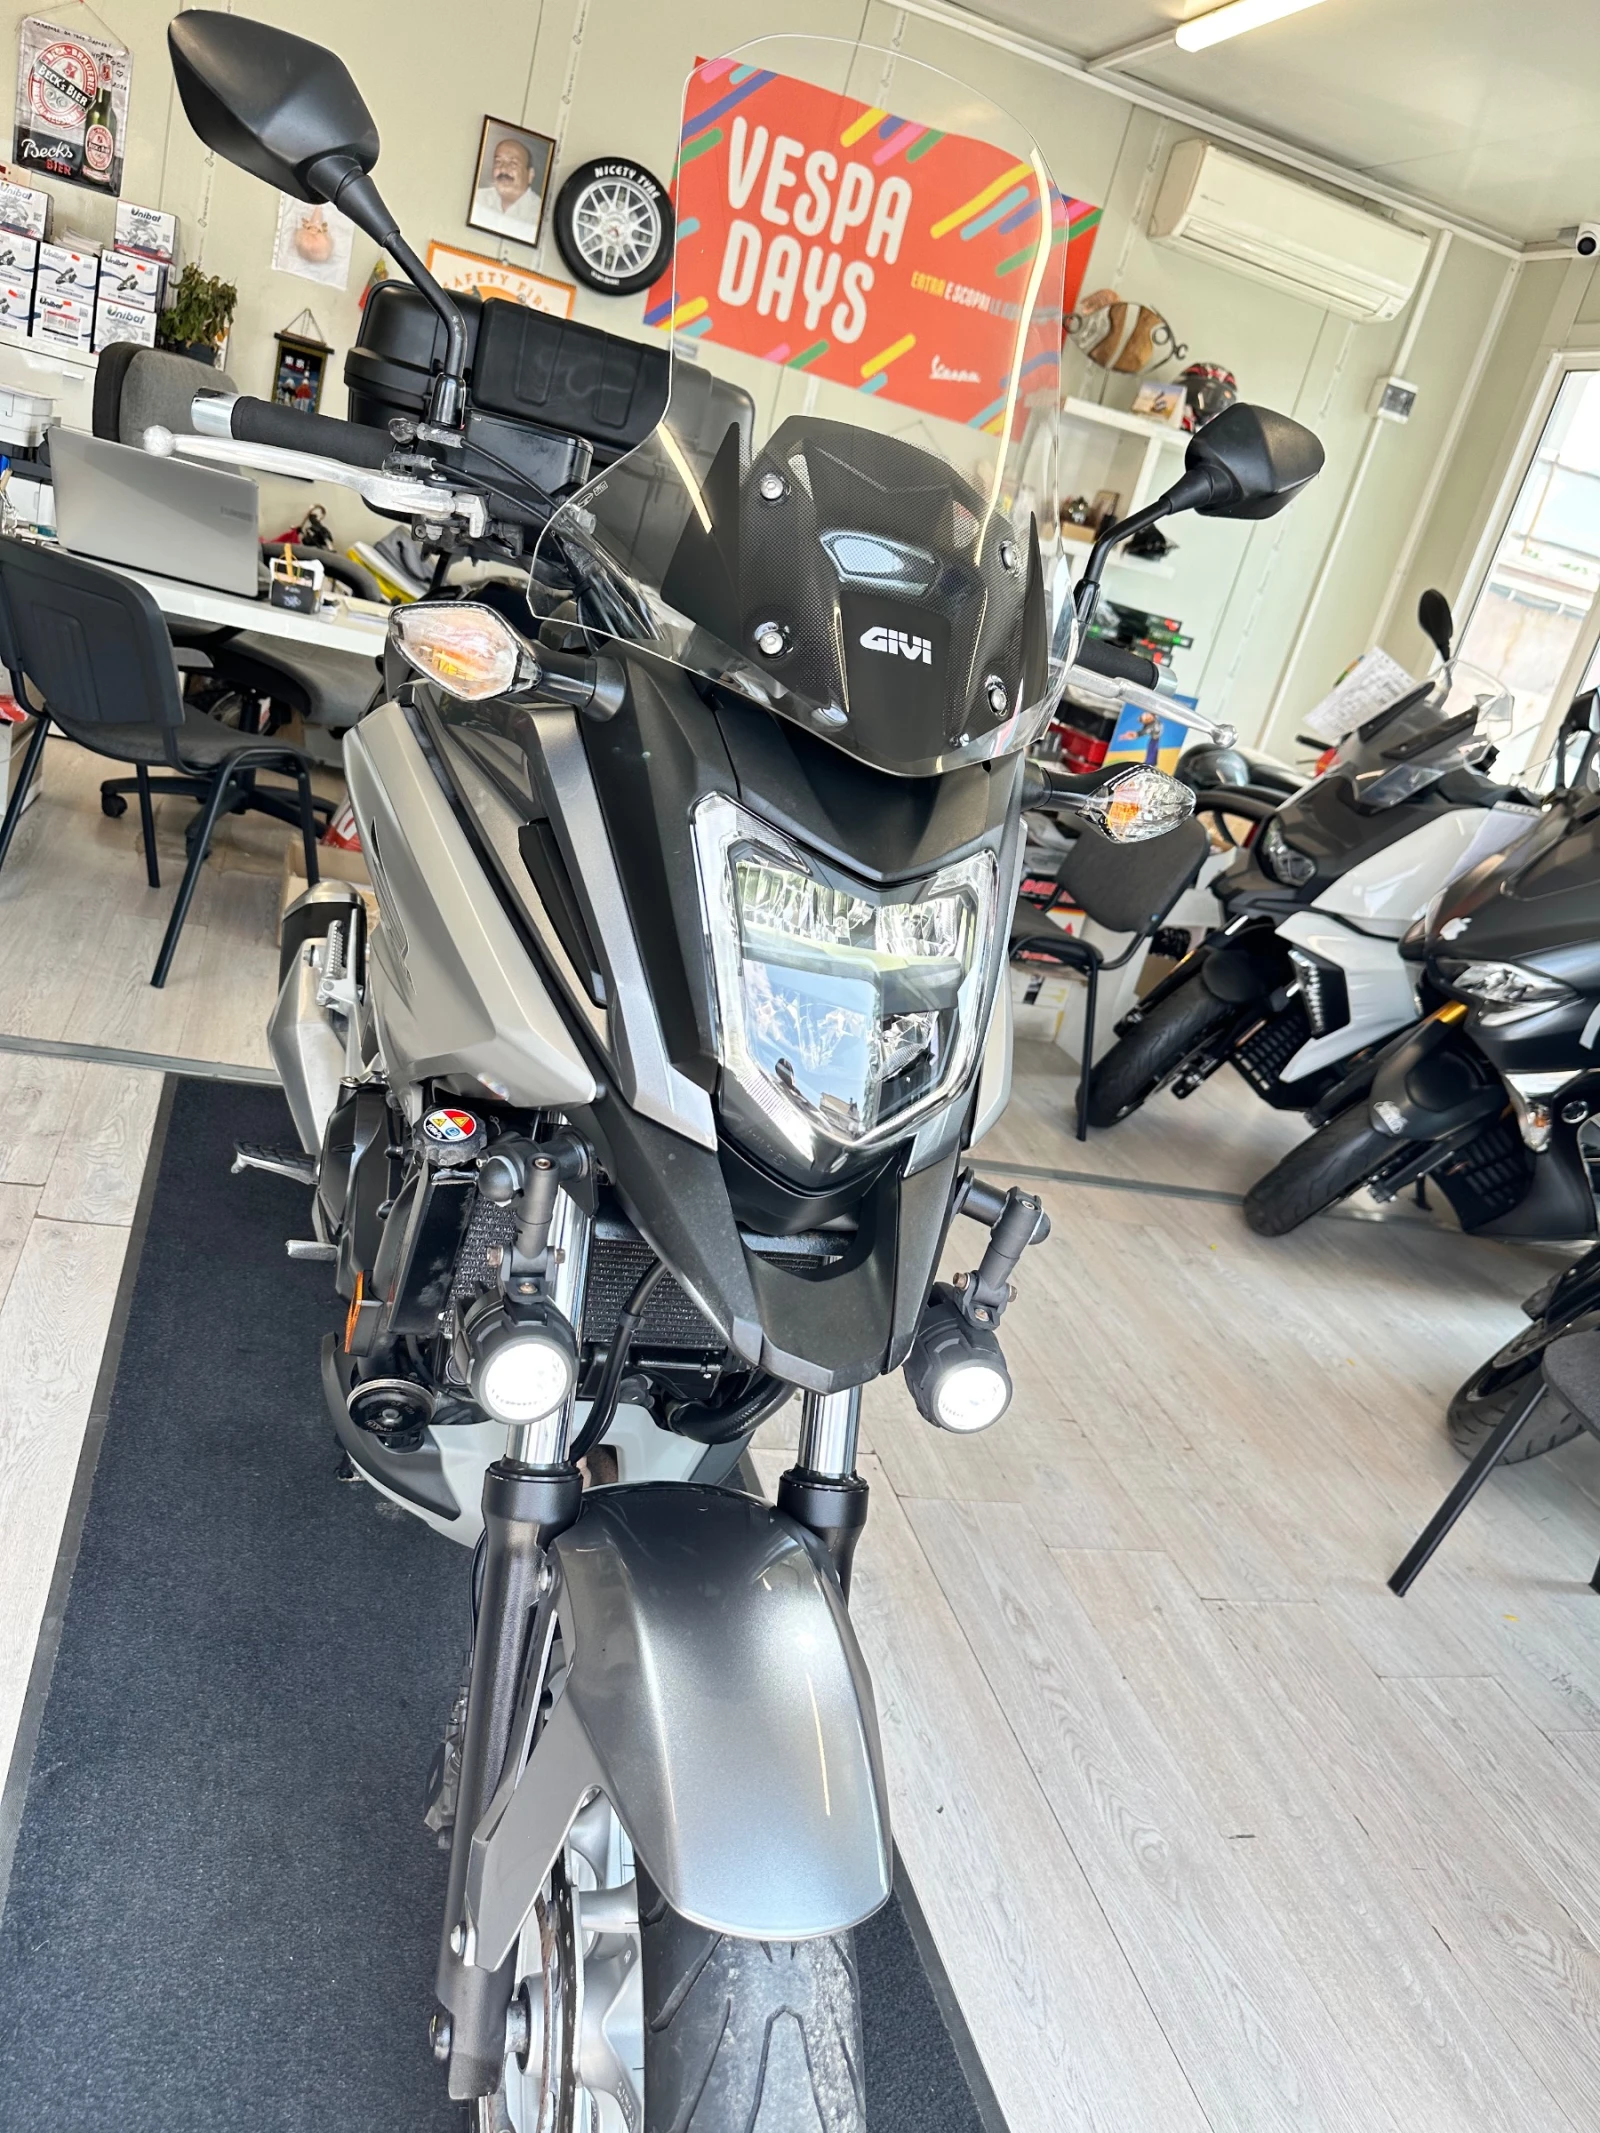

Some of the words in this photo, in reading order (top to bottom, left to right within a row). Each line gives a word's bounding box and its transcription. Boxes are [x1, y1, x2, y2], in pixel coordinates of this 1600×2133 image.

[65, 84, 88, 106] BIER
[45, 159, 71, 176] BIER
[0, 182, 33, 200] Unibat
[594, 165, 637, 179] NICETY
[637, 174, 661, 200] TYRE
[728, 116, 912, 264] VESPA
[131, 208, 161, 222] Unibat
[43, 248, 67, 262] Unibat
[105, 255, 129, 267] Unibat
[718, 220, 874, 343] DAYS
[944, 281, 955, 302] E
[39, 297, 63, 309] Unibat
[517, 282, 550, 311] FIR
[107, 305, 145, 324] Unibat
[860, 626, 931, 665] GIVI
